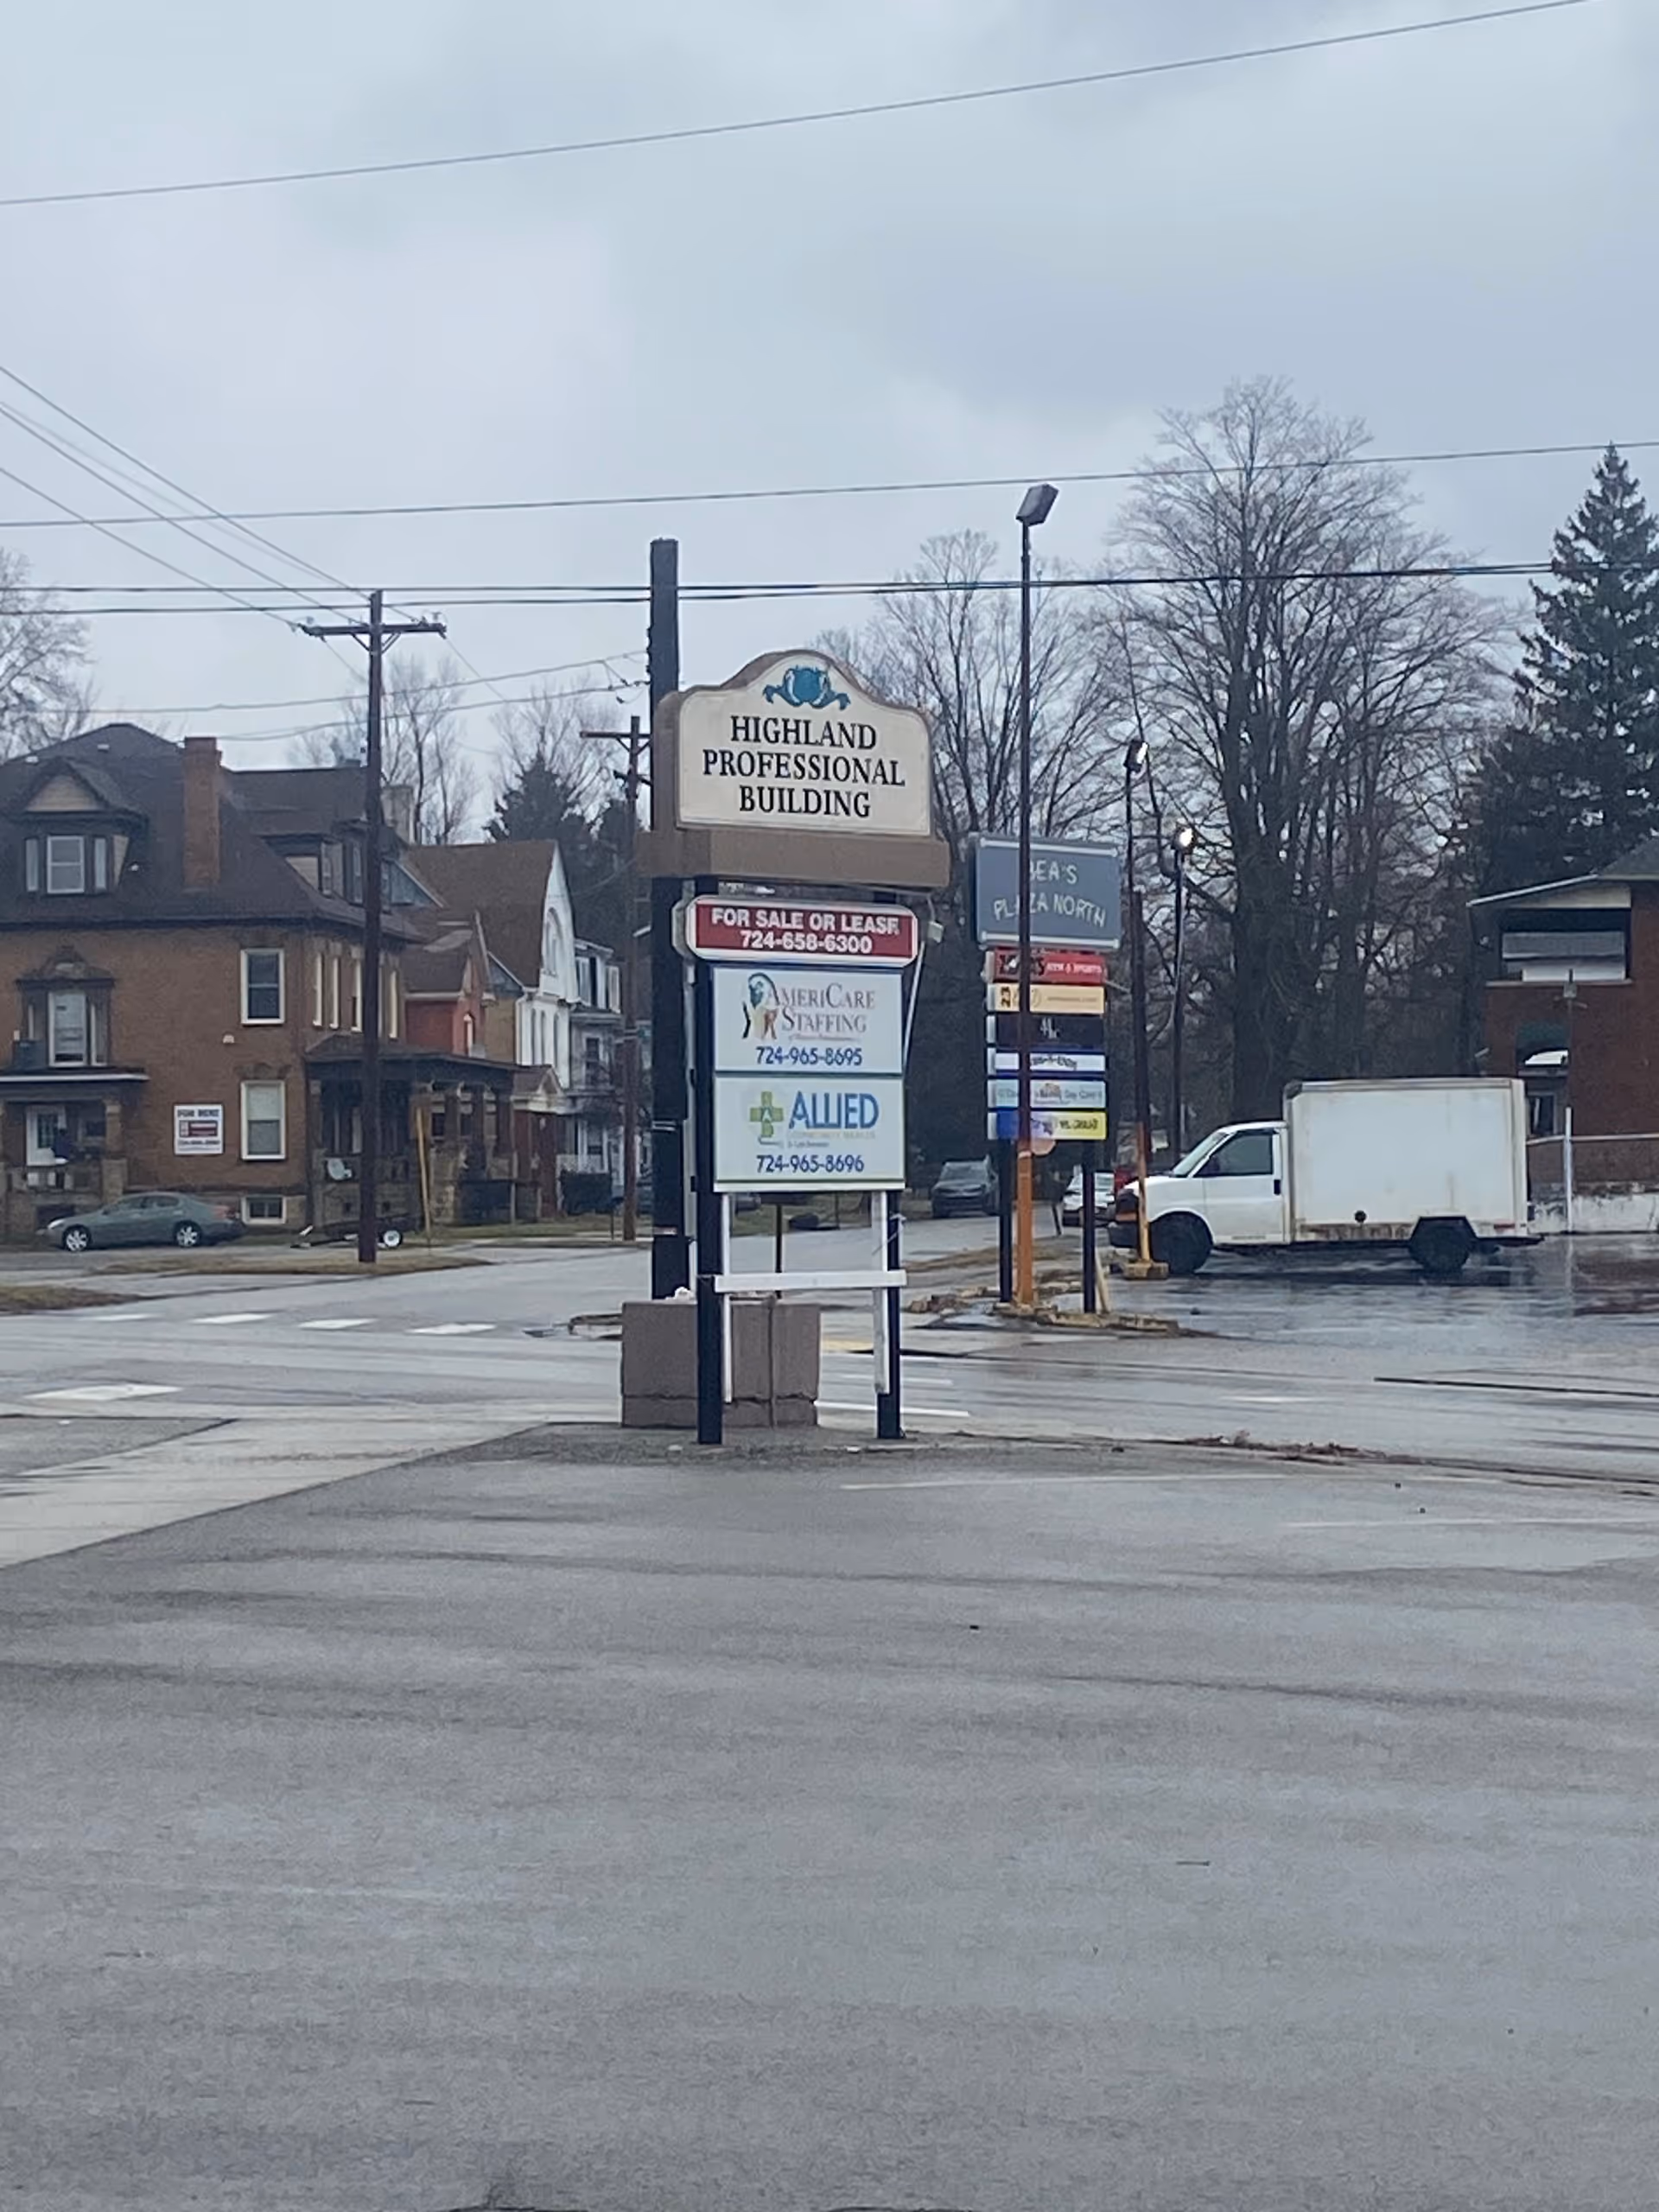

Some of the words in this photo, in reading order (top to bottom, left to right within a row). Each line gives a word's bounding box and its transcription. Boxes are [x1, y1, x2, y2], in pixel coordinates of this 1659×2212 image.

[731, 715, 877, 750] HIGHLAND
[702, 749, 906, 787] PROFESSIONAL
[740, 785, 871, 818] BUILDING
[711, 907, 750, 928] FOR
[755, 910, 804, 930] SALE
[809, 913, 836, 931] OR
[841, 914, 900, 936] LEASE
[1053, 893, 1106, 928] NORTH
[740, 930, 874, 954] 724-658-6300
[755, 1046, 862, 1066] 724-965-8695
[788, 1090, 880, 1129] ALLIED
[755, 1154, 865, 1173] 724-965-8696
